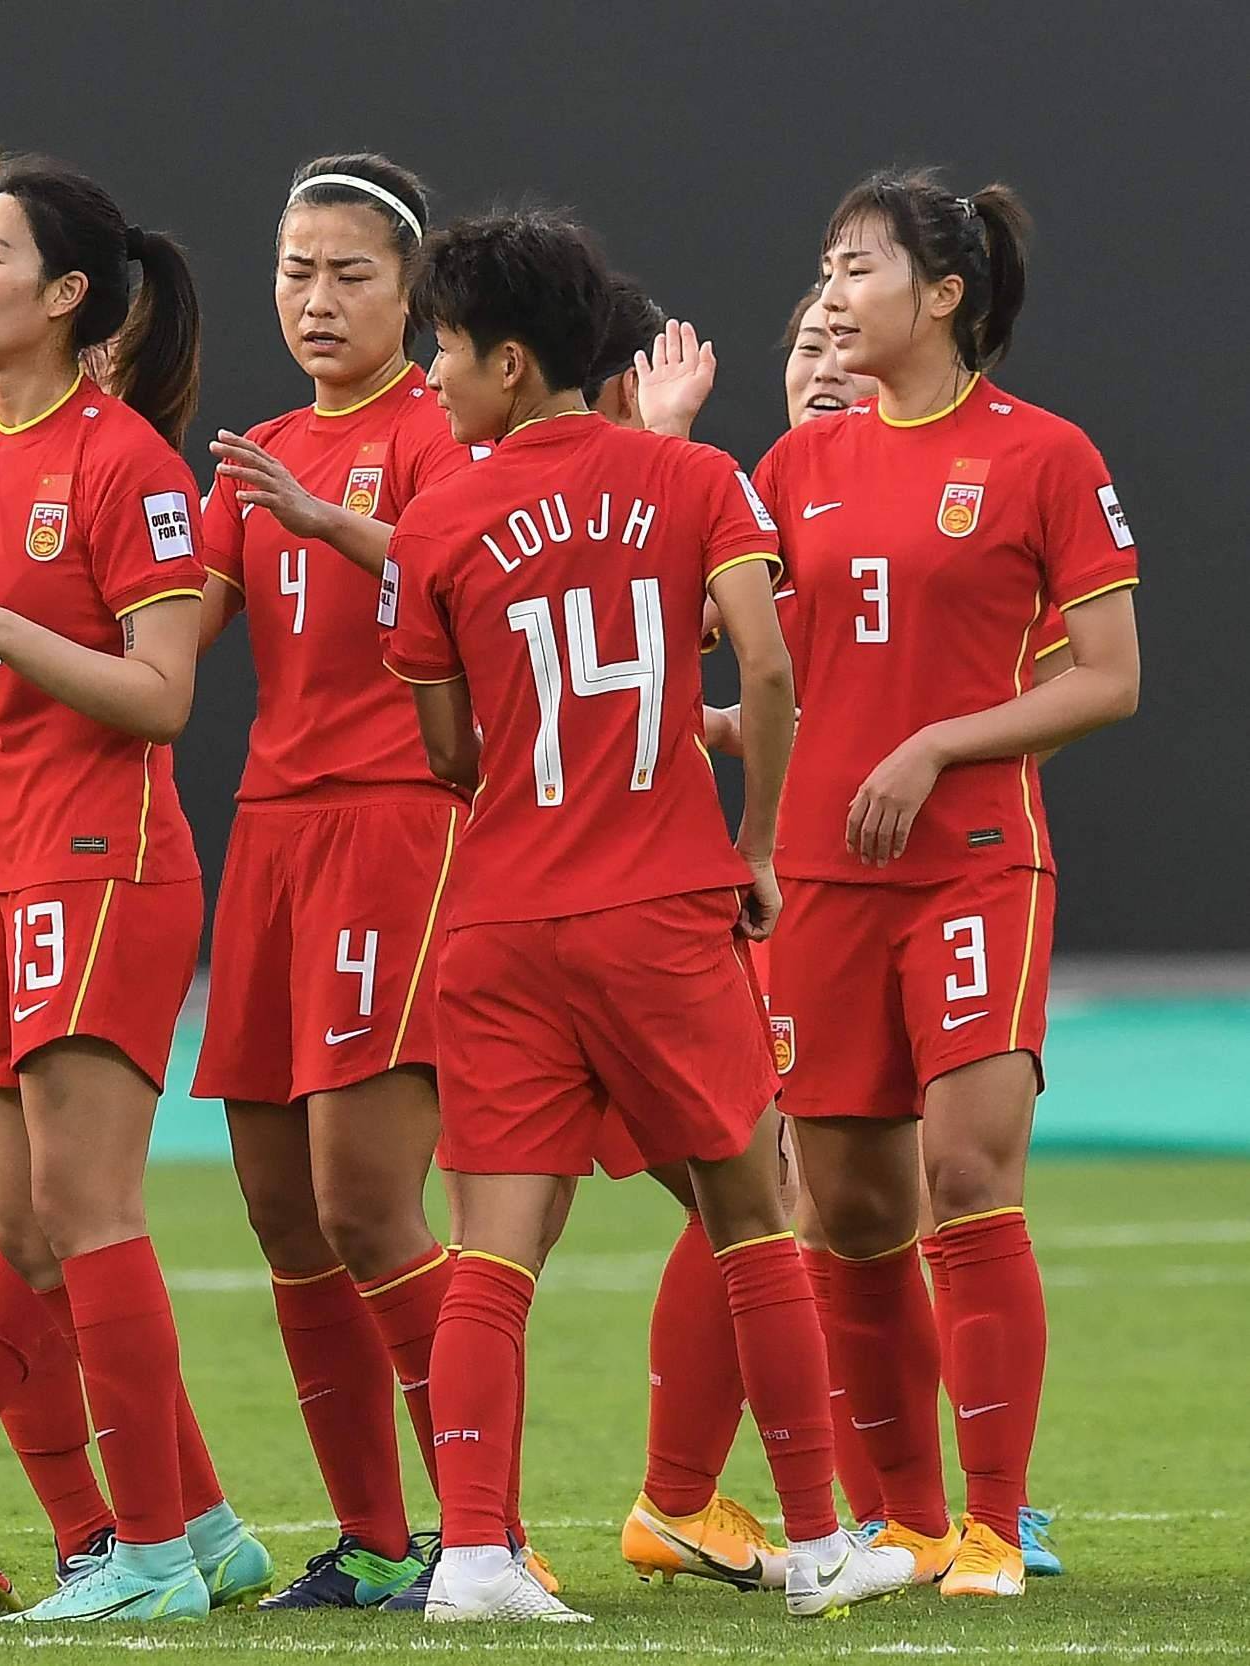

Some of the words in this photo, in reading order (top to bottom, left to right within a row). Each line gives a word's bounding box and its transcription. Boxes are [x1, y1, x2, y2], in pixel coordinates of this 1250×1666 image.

[352, 472, 378, 483] CFA
[948, 489, 978, 500] CFA
[35, 508, 63, 520] CFA
[152, 512, 171, 527] OUR
[158, 526, 177, 540] FOR
[481, 493, 572, 573] LOU
[280, 548, 307, 634] 4
[851, 557, 889, 643] 3
[506, 577, 665, 807] 14
[13, 900, 65, 994] 13
[943, 915, 988, 1002] 3
[336, 929, 378, 1016] 4
[771, 1022, 790, 1032] CFA
[433, 1430, 479, 1447] CFA
